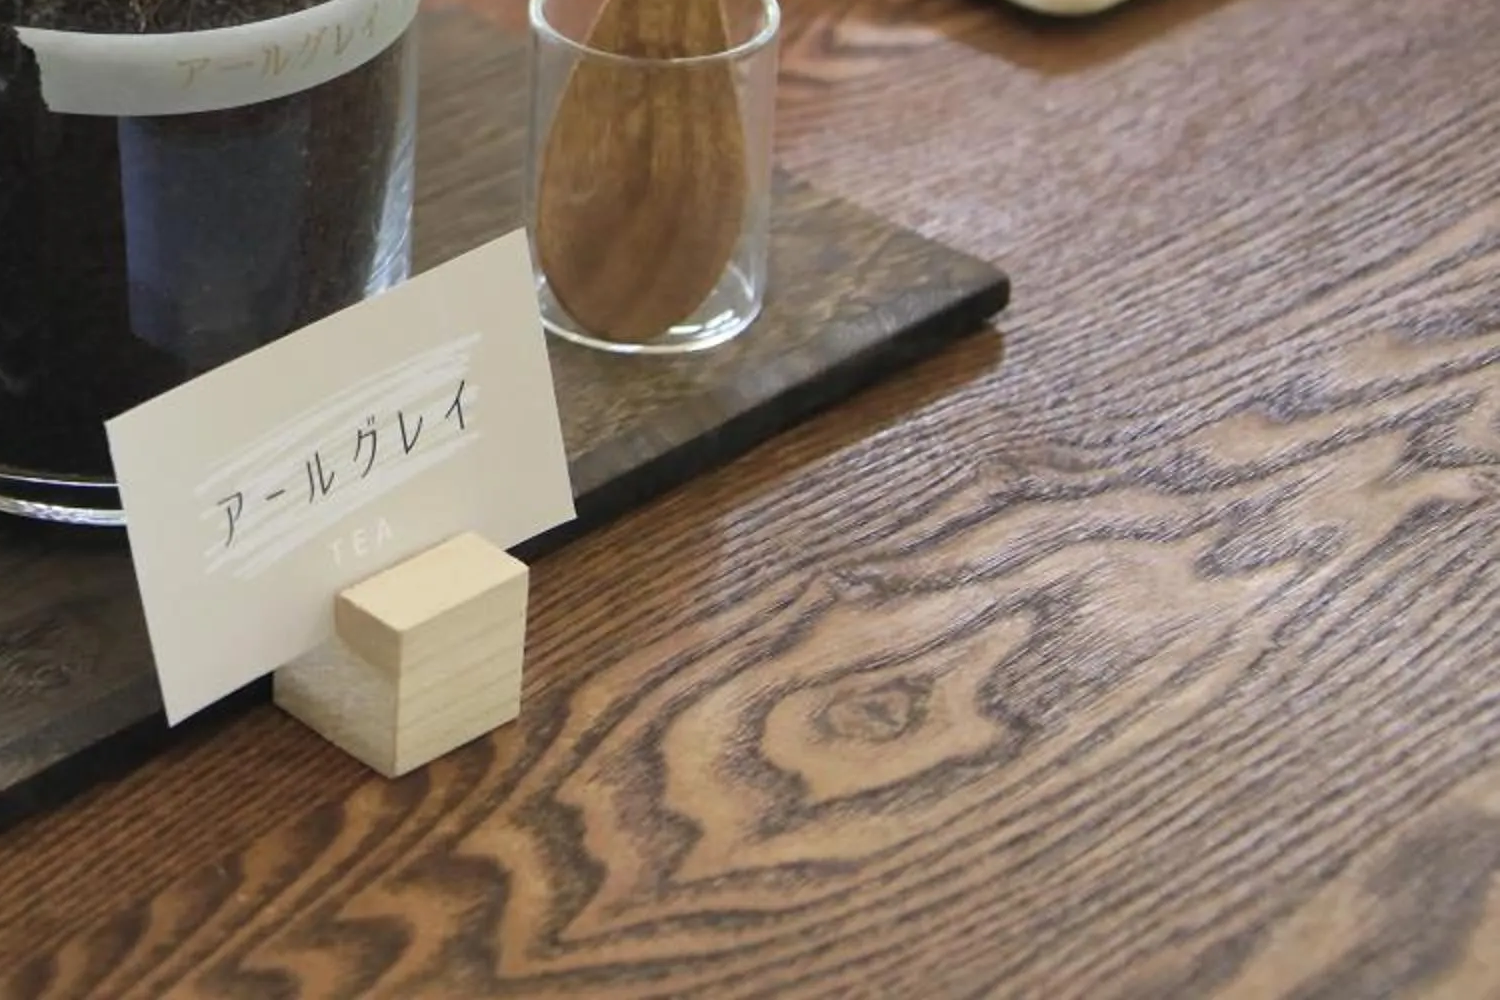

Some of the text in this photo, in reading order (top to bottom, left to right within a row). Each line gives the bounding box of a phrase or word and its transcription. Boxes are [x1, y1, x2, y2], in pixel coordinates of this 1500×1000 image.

[216, 379, 466, 548] アールグレイ
[326, 516, 394, 568] TEA
